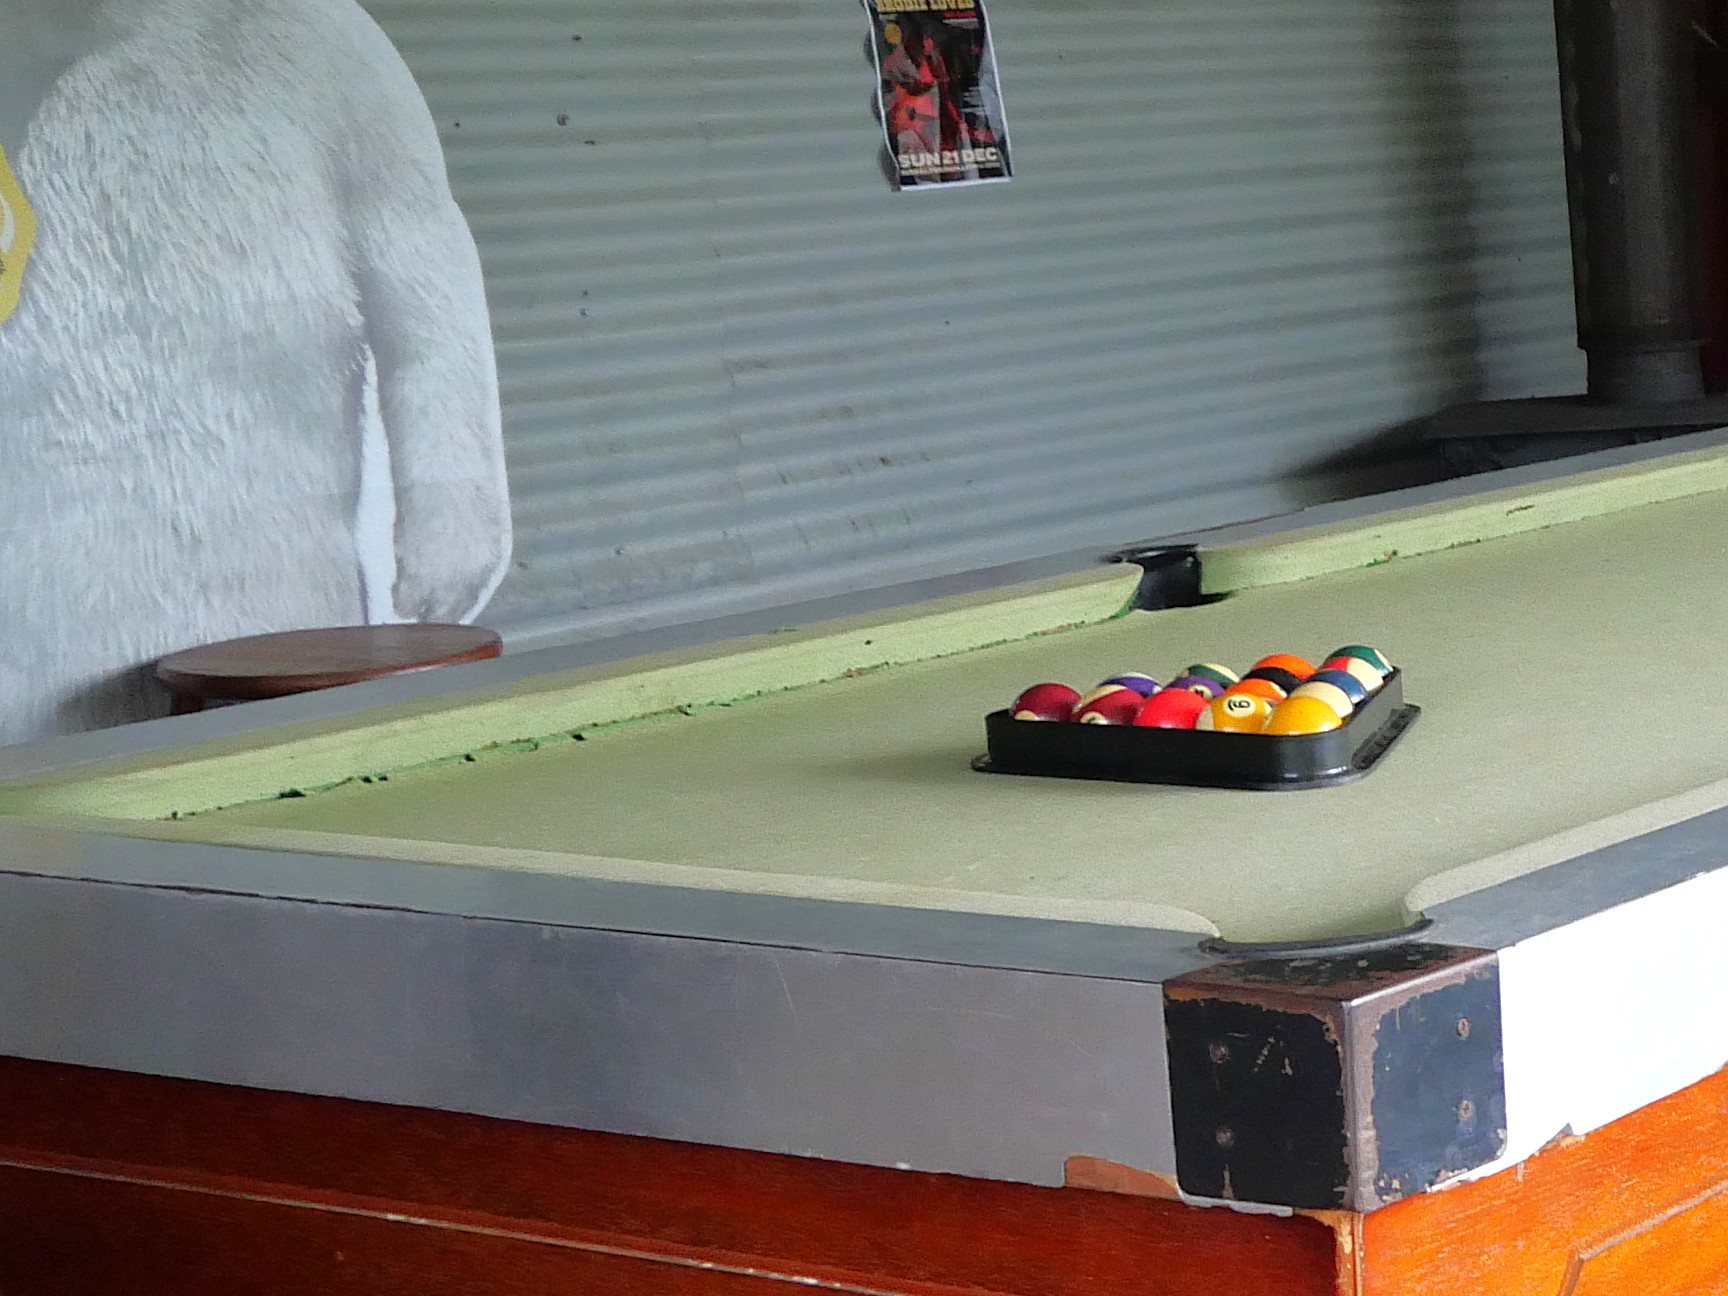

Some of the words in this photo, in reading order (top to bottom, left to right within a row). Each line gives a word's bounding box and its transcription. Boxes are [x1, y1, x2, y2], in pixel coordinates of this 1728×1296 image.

[897, 152, 940, 168] SUN
[942, 149, 959, 164] 21
[962, 147, 997, 163] DEC
